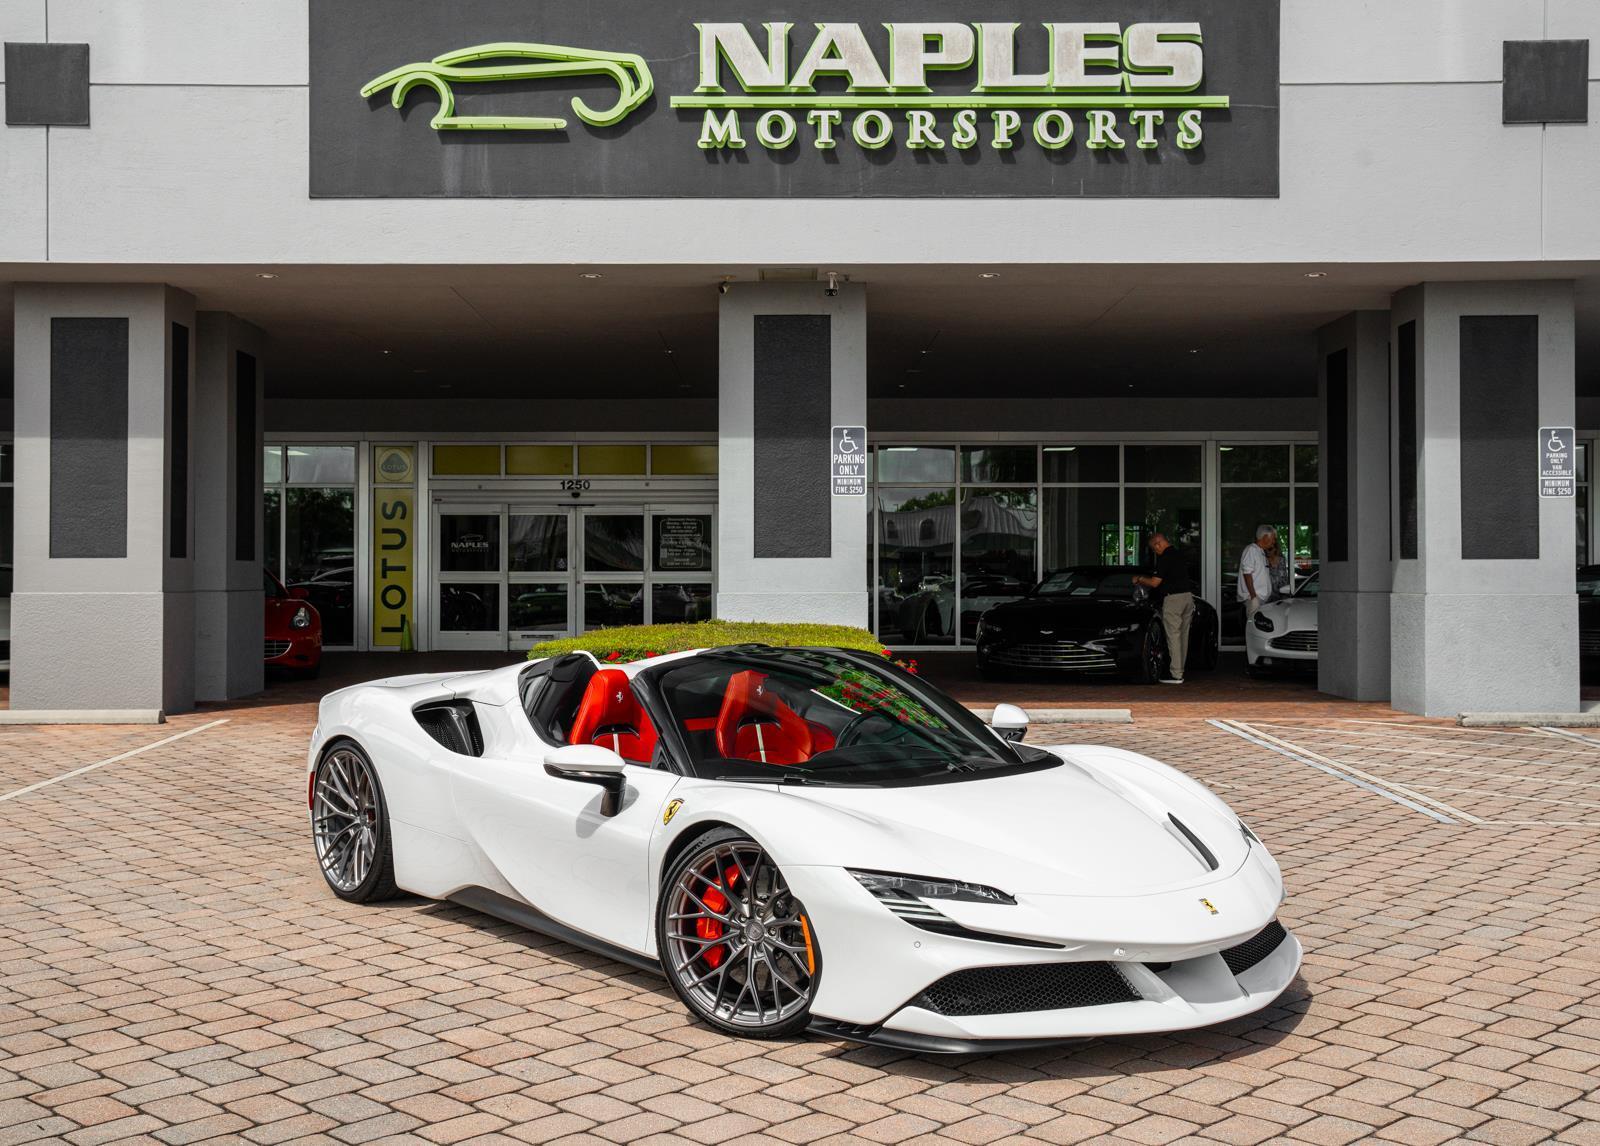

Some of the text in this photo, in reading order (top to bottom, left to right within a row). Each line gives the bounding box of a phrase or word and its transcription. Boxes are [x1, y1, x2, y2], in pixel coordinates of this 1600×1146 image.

[693, 22, 1203, 93] NAPLES
[697, 109, 1203, 150] MOTORSPORTS
[834, 454, 864, 464] PARKING
[839, 465, 858, 475] ONLY
[560, 480, 591, 490] 1250
[381, 500, 407, 633] LOTUS
